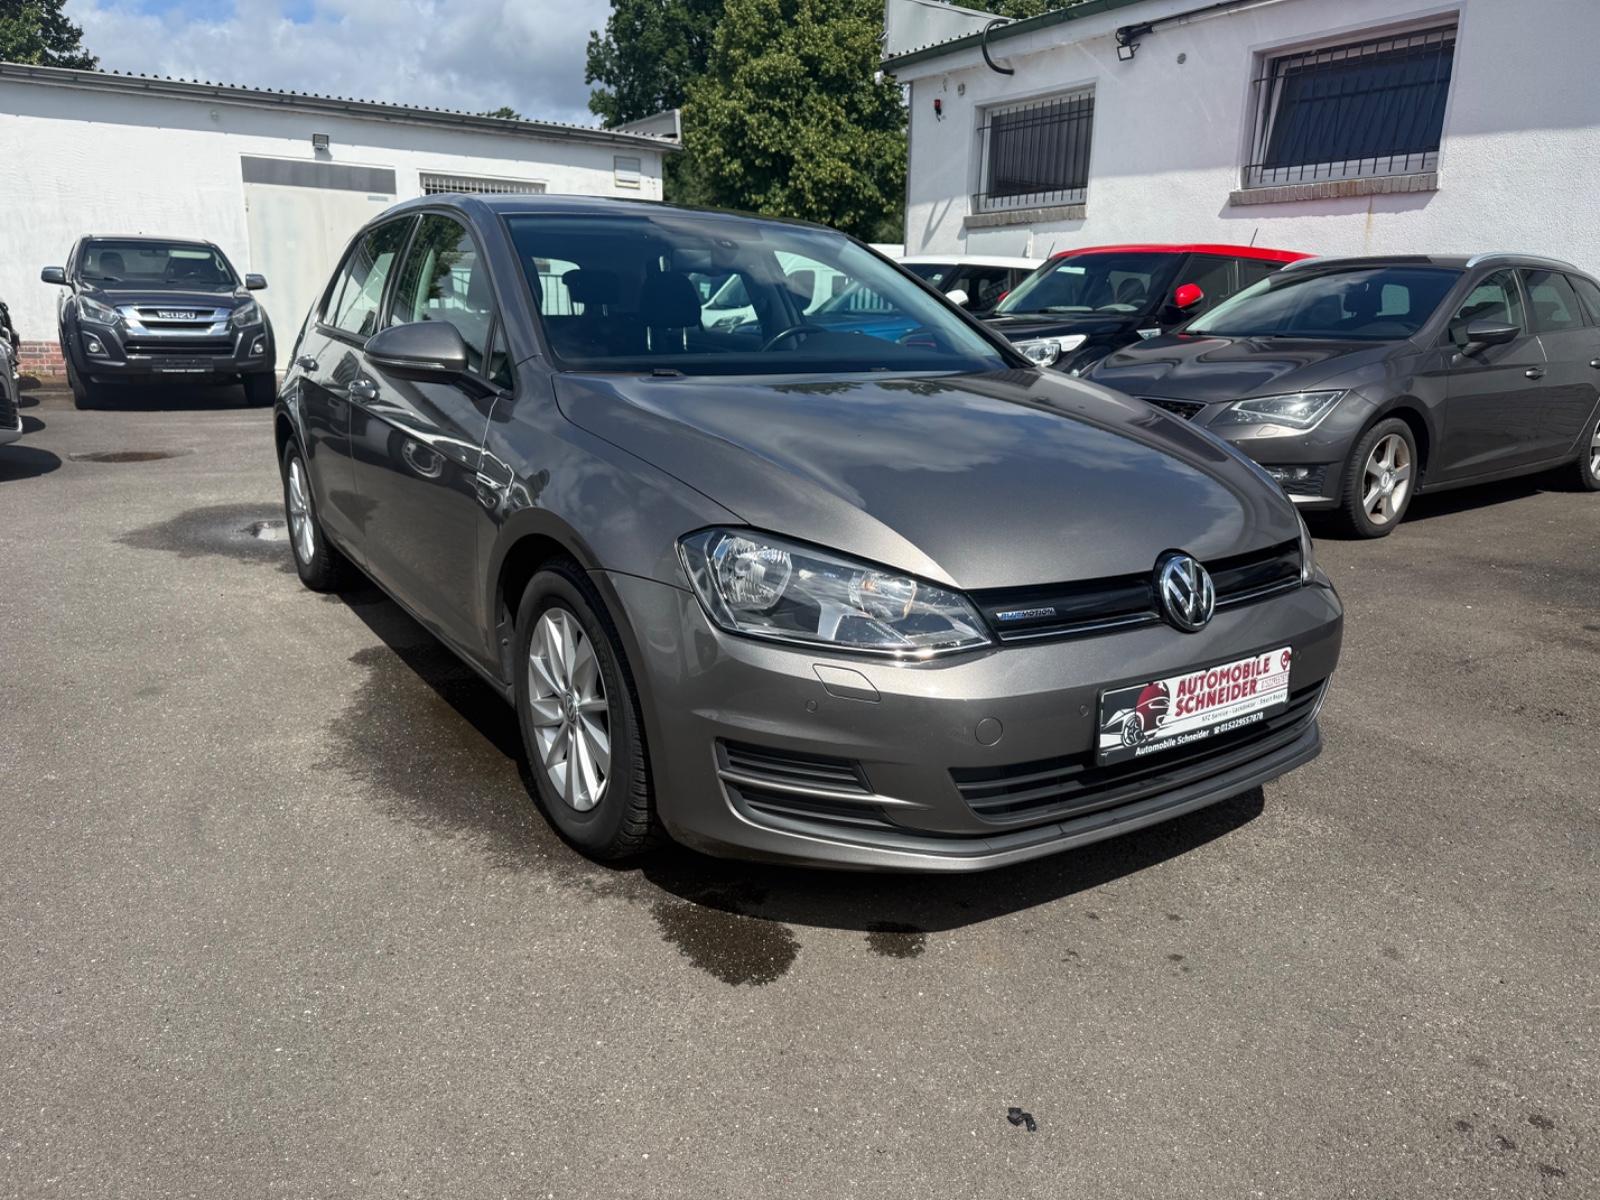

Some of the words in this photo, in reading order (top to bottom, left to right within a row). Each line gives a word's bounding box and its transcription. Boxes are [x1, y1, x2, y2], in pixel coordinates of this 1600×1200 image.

[157, 310, 196, 319] ISUZU
[1177, 657, 1270, 698] AUTOMOBILE
[1175, 679, 1258, 717] SCHNEIDER
[1135, 738, 1176, 756] Automobile
[1177, 730, 1210, 745] Schneider
